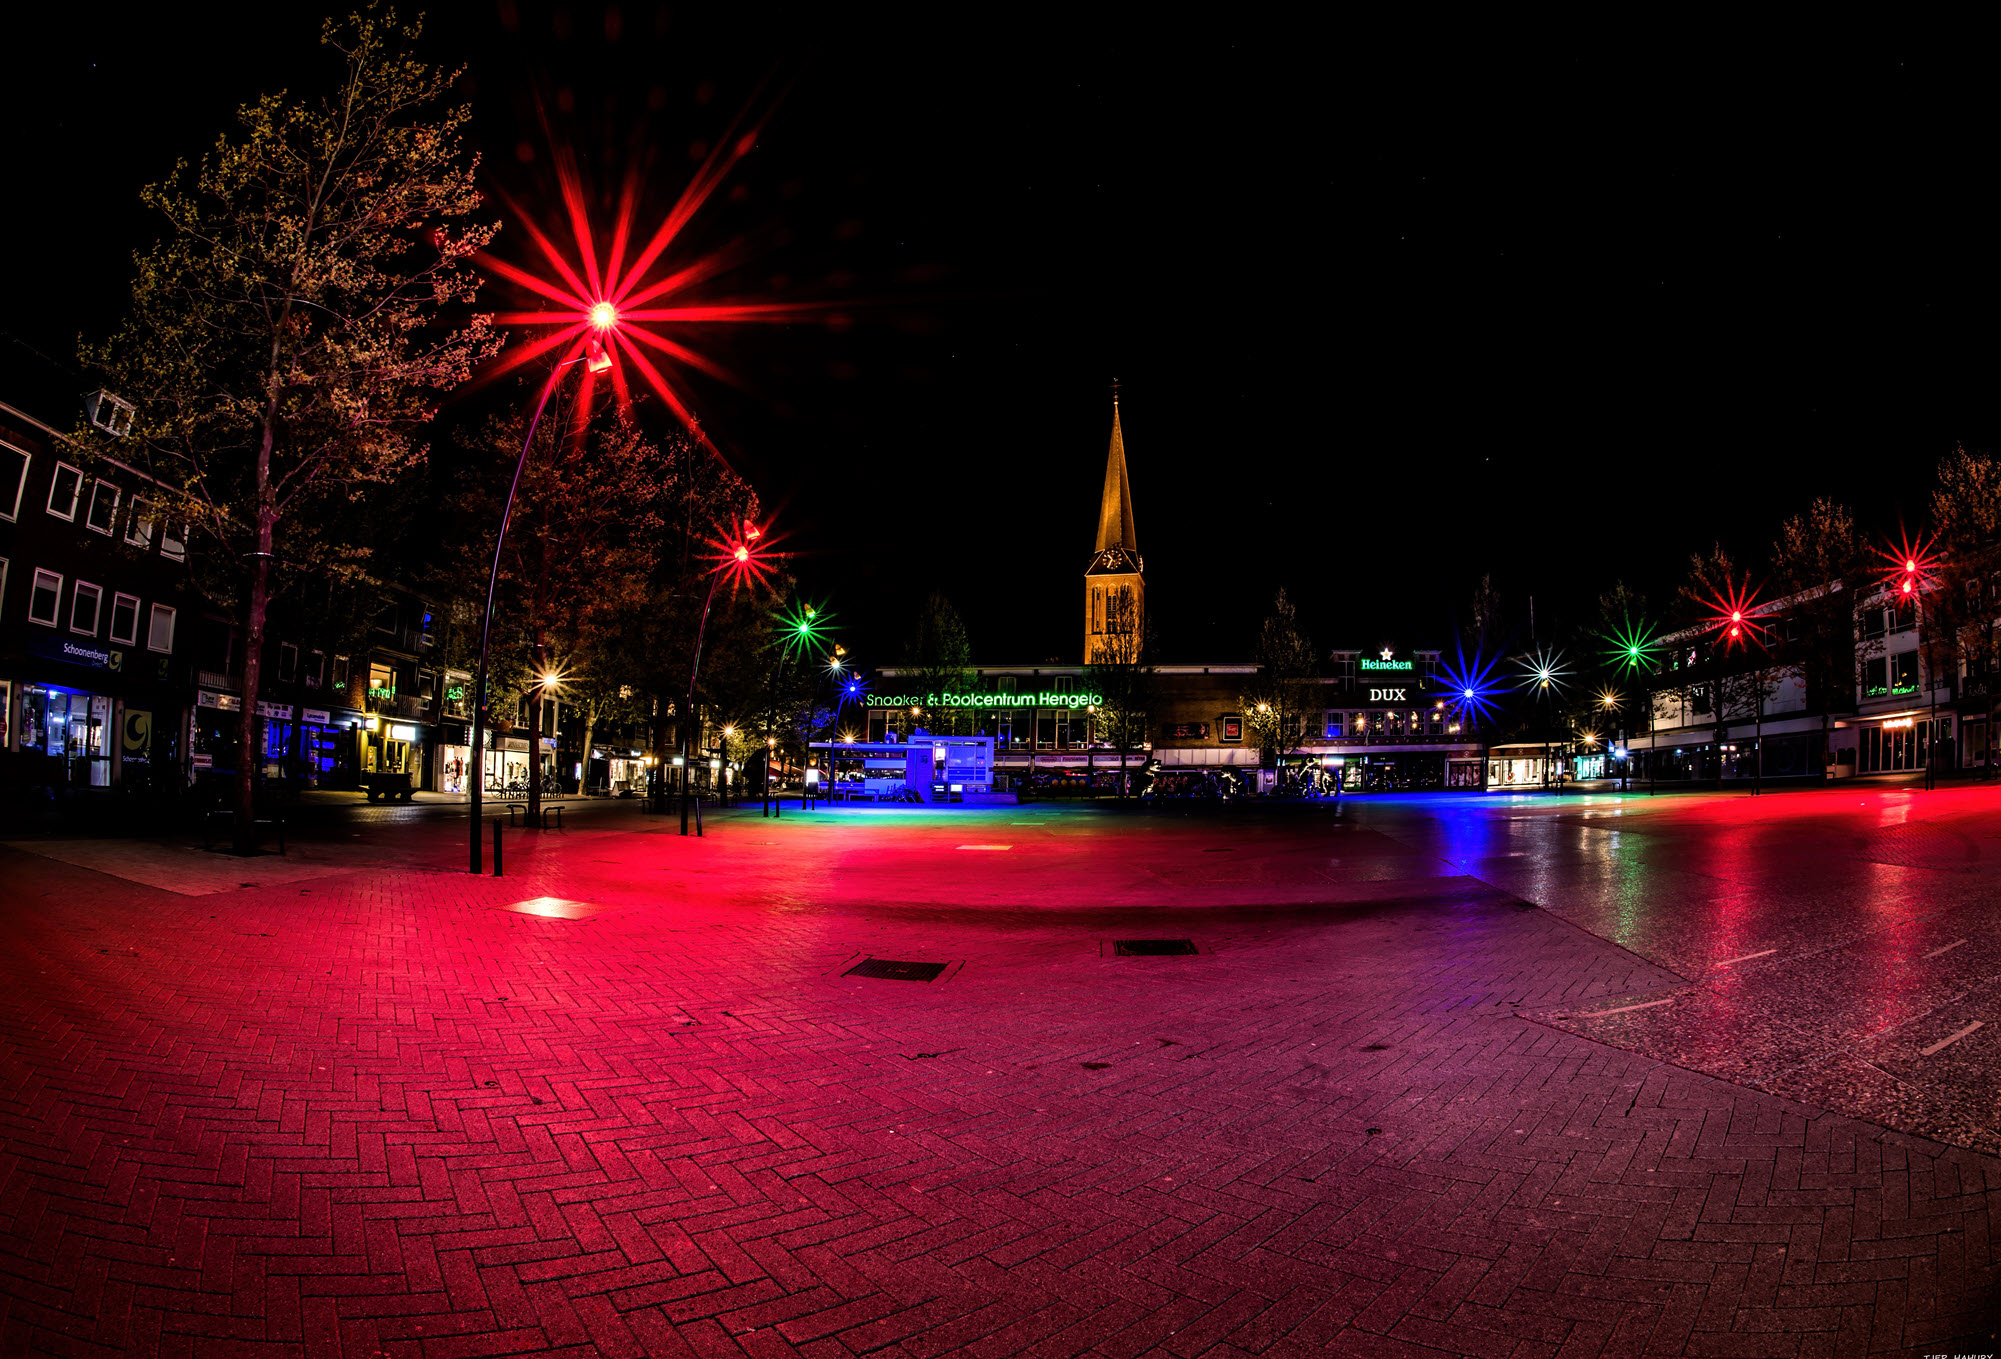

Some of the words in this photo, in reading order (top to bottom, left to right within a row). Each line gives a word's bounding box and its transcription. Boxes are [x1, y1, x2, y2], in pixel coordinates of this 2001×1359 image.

[64, 643, 109, 664] Schoonenberg
[1361, 659, 1412, 670] Heineken
[866, 693, 923, 707] Snooker
[927, 693, 938, 706] &
[942, 692, 1035, 707] Poolcentrum
[1039, 692, 1103, 709] Hengelo
[1370, 689, 1406, 701] DUX
